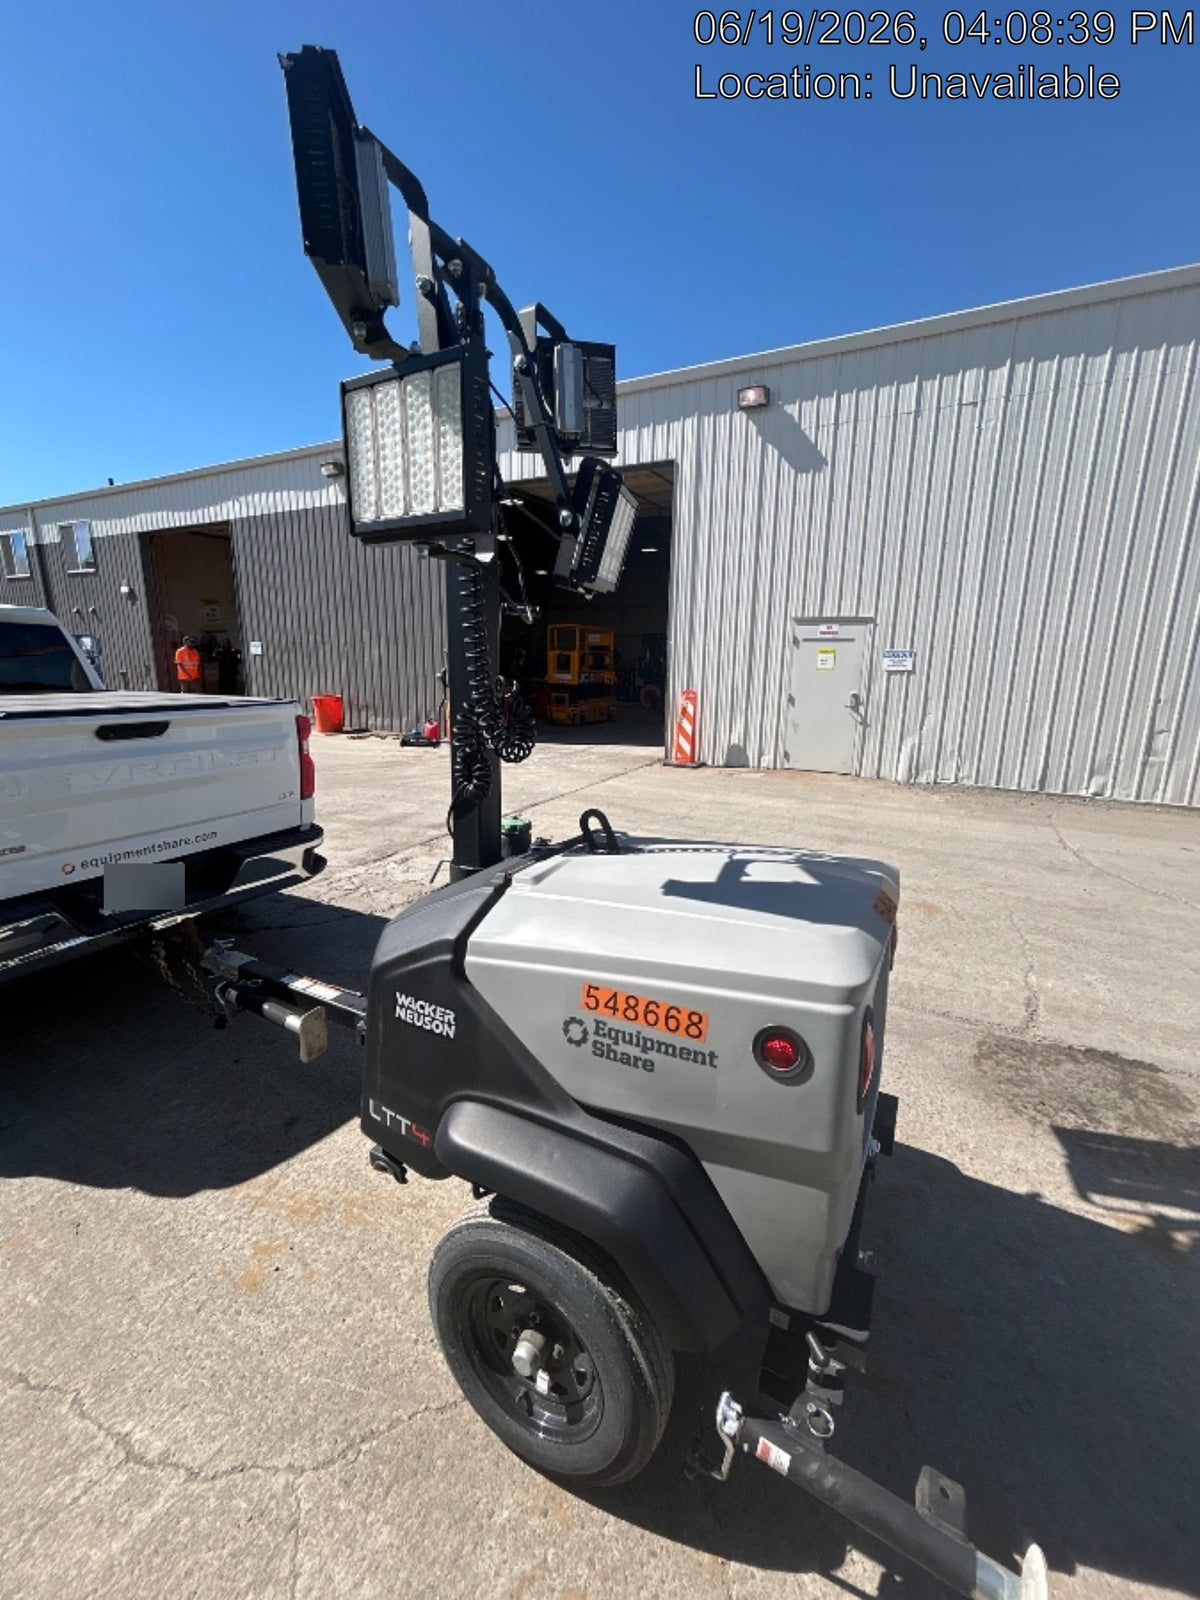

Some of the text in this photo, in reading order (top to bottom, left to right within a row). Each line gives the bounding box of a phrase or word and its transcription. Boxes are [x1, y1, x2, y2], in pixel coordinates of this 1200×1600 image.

[80, 831, 218, 870] equipmentshare.com
[395, 991, 456, 1025] WACKER
[395, 1005, 456, 1039] NEUSON
[584, 984, 704, 1039] 548668
[591, 1039, 656, 1073] Share
[593, 1018, 719, 1069] Equipment
[369, 1097, 431, 1147] LTT4
